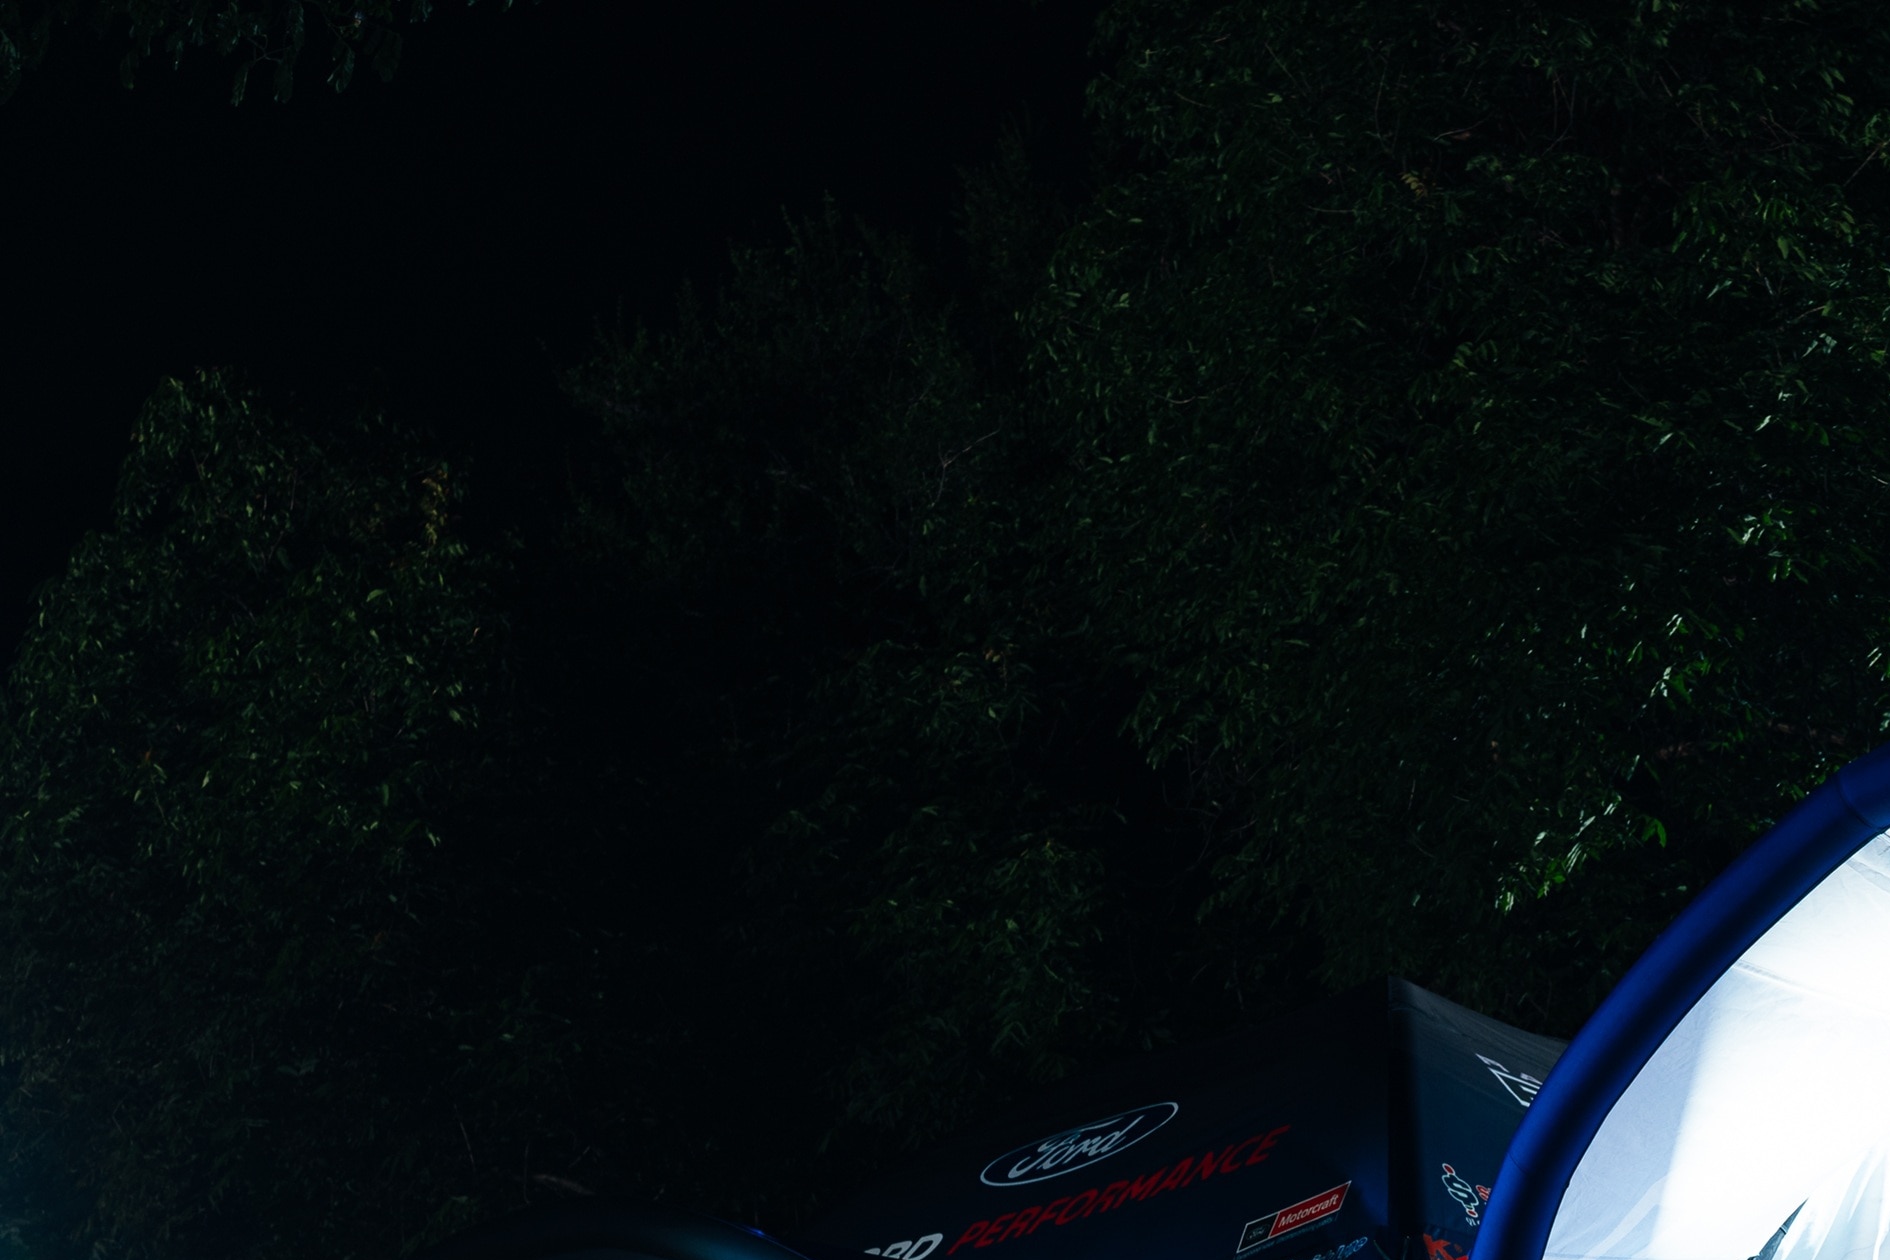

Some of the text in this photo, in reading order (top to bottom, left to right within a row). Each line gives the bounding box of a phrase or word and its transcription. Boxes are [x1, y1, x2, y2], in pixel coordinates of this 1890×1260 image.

[1007, 1114, 1145, 1180] Ford
[946, 1124, 1292, 1256] PERFORMANCE
[1278, 1193, 1340, 1229] Motorcraft
